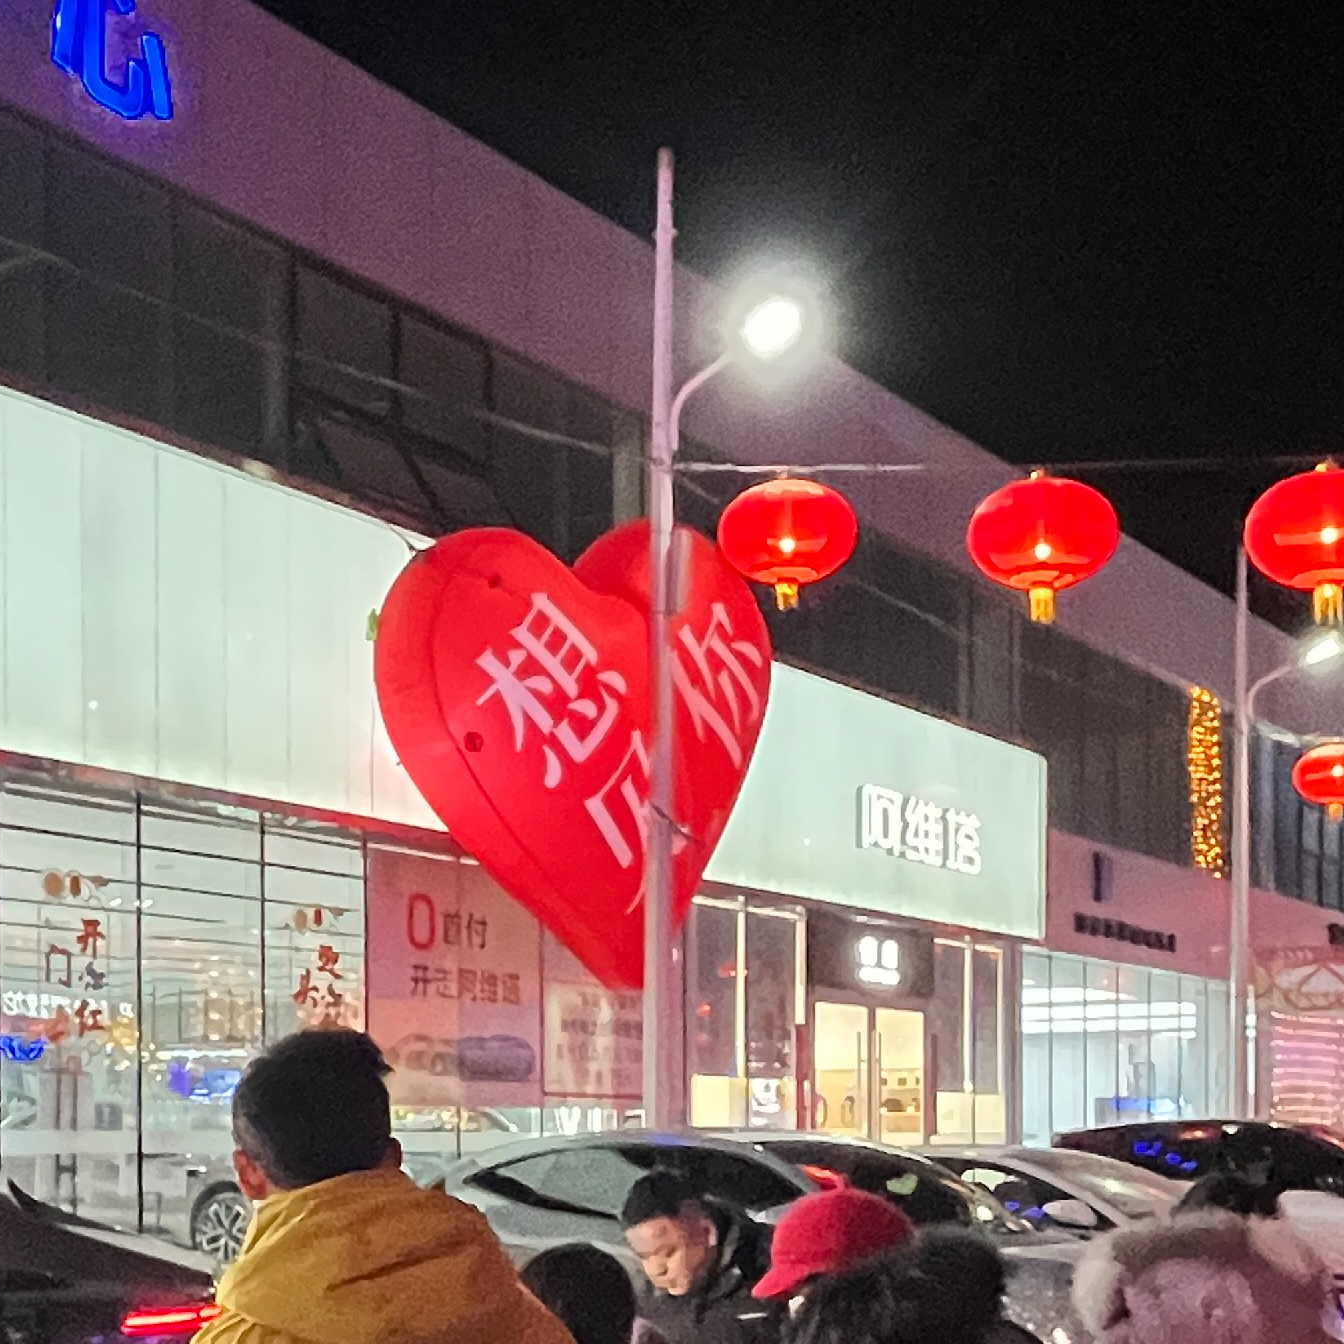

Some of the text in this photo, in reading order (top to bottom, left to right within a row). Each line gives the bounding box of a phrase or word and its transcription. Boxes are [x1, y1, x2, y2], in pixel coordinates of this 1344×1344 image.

[856, 782, 982, 876] 阿维塔
[407, 892, 489, 951] 0首付
